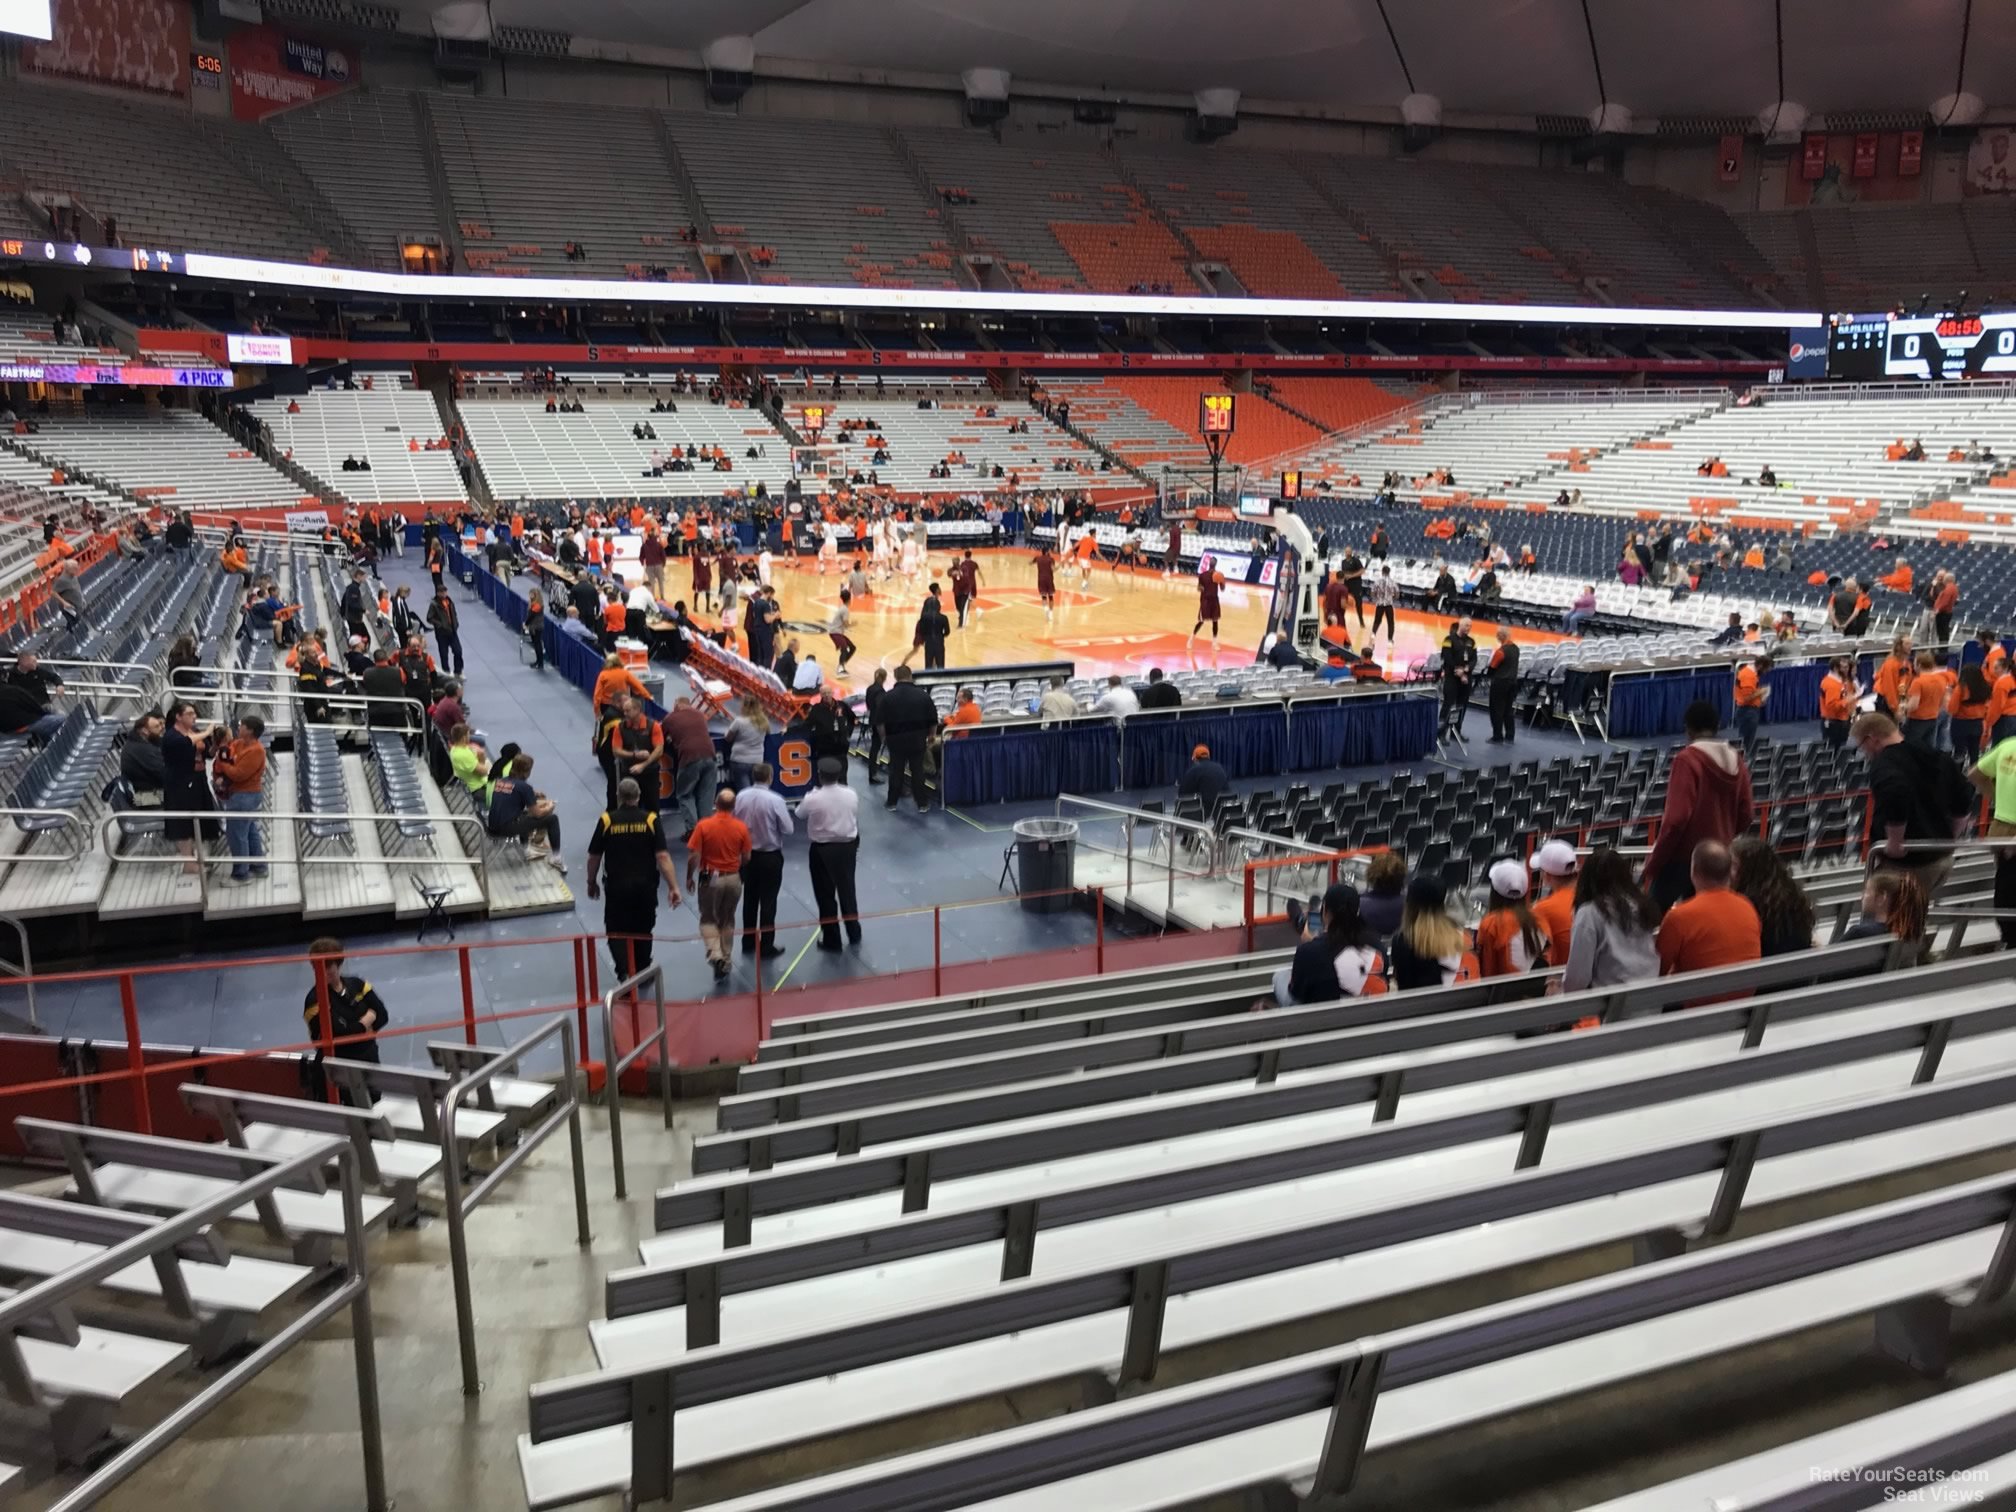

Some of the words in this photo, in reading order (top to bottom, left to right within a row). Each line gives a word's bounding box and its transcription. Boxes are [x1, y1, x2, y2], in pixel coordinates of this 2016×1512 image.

[287, 39, 322, 61] United
[198, 55, 222, 73] 6:06
[302, 58, 323, 79] Way
[1725, 160, 1736, 173] 7
[2, 240, 24, 256] 1ST
[44, 242, 56, 260] 0
[1904, 335, 1920, 358] 0
[1997, 330, 2015, 355] 0
[588, 347, 599, 361] S
[872, 350, 882, 365] S
[1804, 346, 1827, 358] pepsi
[178, 371, 188, 385] 4
[193, 372, 225, 386] PACK
[1208, 409, 1228, 430] 30
[1262, 563, 1273, 582] S
[778, 740, 812, 788] S
